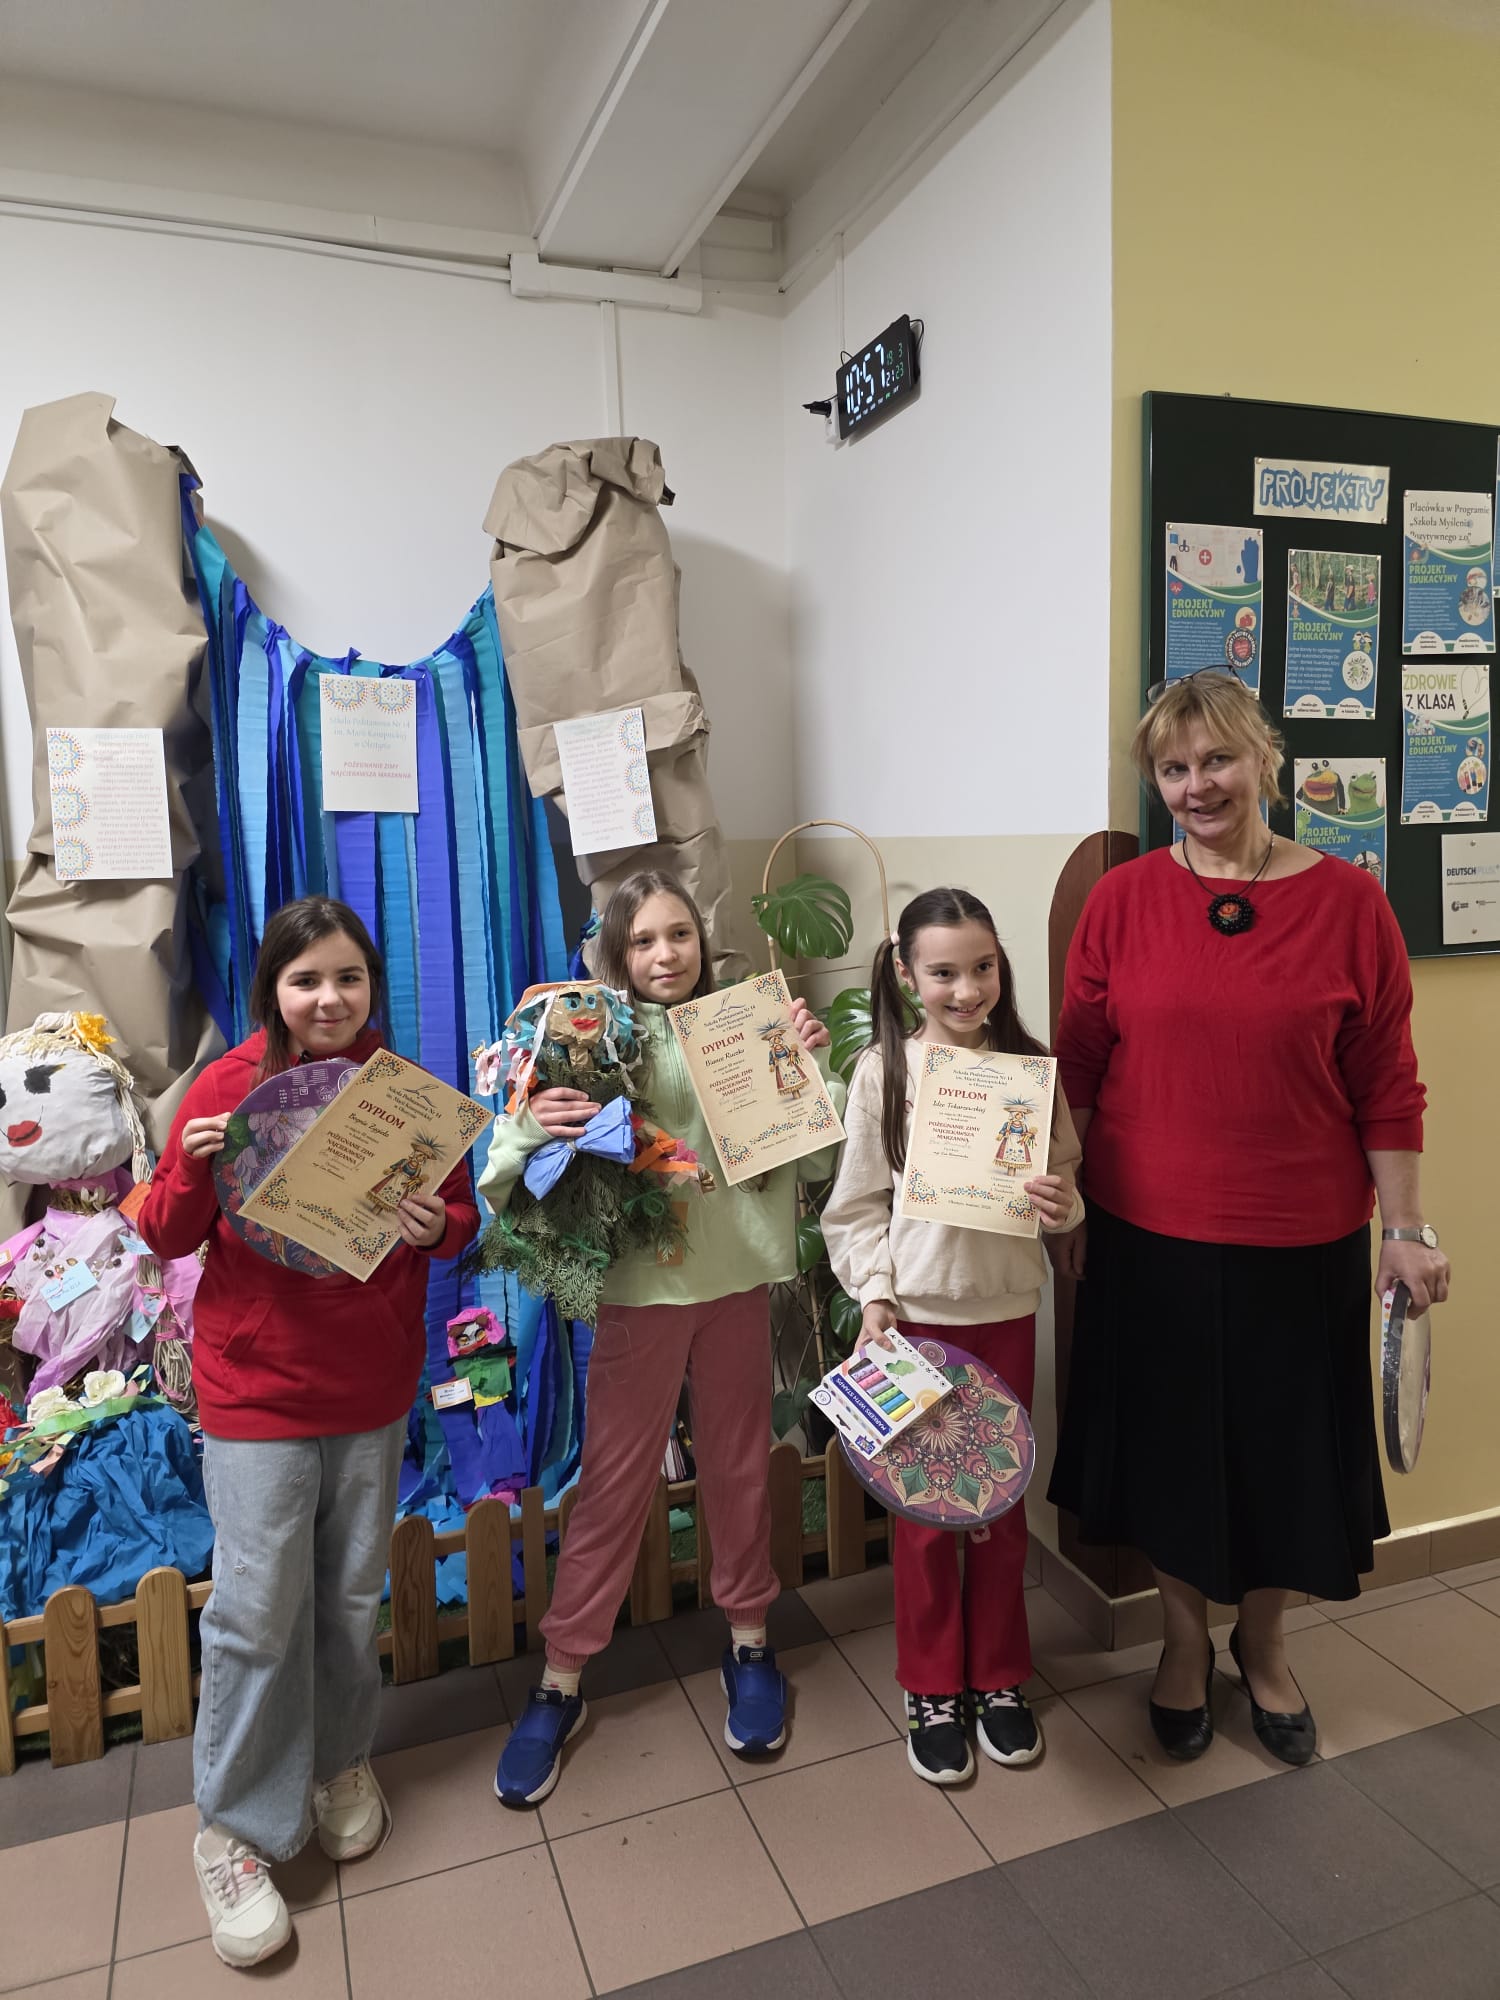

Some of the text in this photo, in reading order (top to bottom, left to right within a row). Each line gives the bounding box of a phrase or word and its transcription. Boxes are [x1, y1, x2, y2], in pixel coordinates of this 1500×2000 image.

[846, 343, 885, 414] 10:57
[1260, 467, 1386, 511] PROJEKTY
[1410, 502, 1444, 512] Placówka
[1454, 504, 1490, 516] Programie
[1409, 565, 1447, 574] PROJEKT
[1409, 574, 1458, 584] EDUKACYJNY
[1172, 598, 1214, 609] PROJEKT
[1172, 609, 1226, 618] EDUKACYJNY
[1293, 622, 1332, 632] PROJEKT
[1293, 632, 1344, 641] EDUKACYJNY
[1403, 674, 1457, 690] ZDROWIE
[1409, 736, 1447, 746] PROJEKT
[1409, 745, 1457, 756] EDUKACYJNY
[1302, 827, 1340, 837] PROJEKT
[1447, 867, 1477, 877] DEUTSCH
[701, 1032, 744, 1055] DYPLOM
[938, 1087, 987, 1101] DYPLOM
[357, 1098, 405, 1130] DYPLOM
[834, 1377, 855, 1397] STAMPS
[851, 1394, 867, 1410] WITH
[863, 1407, 887, 1431] MARKERS
